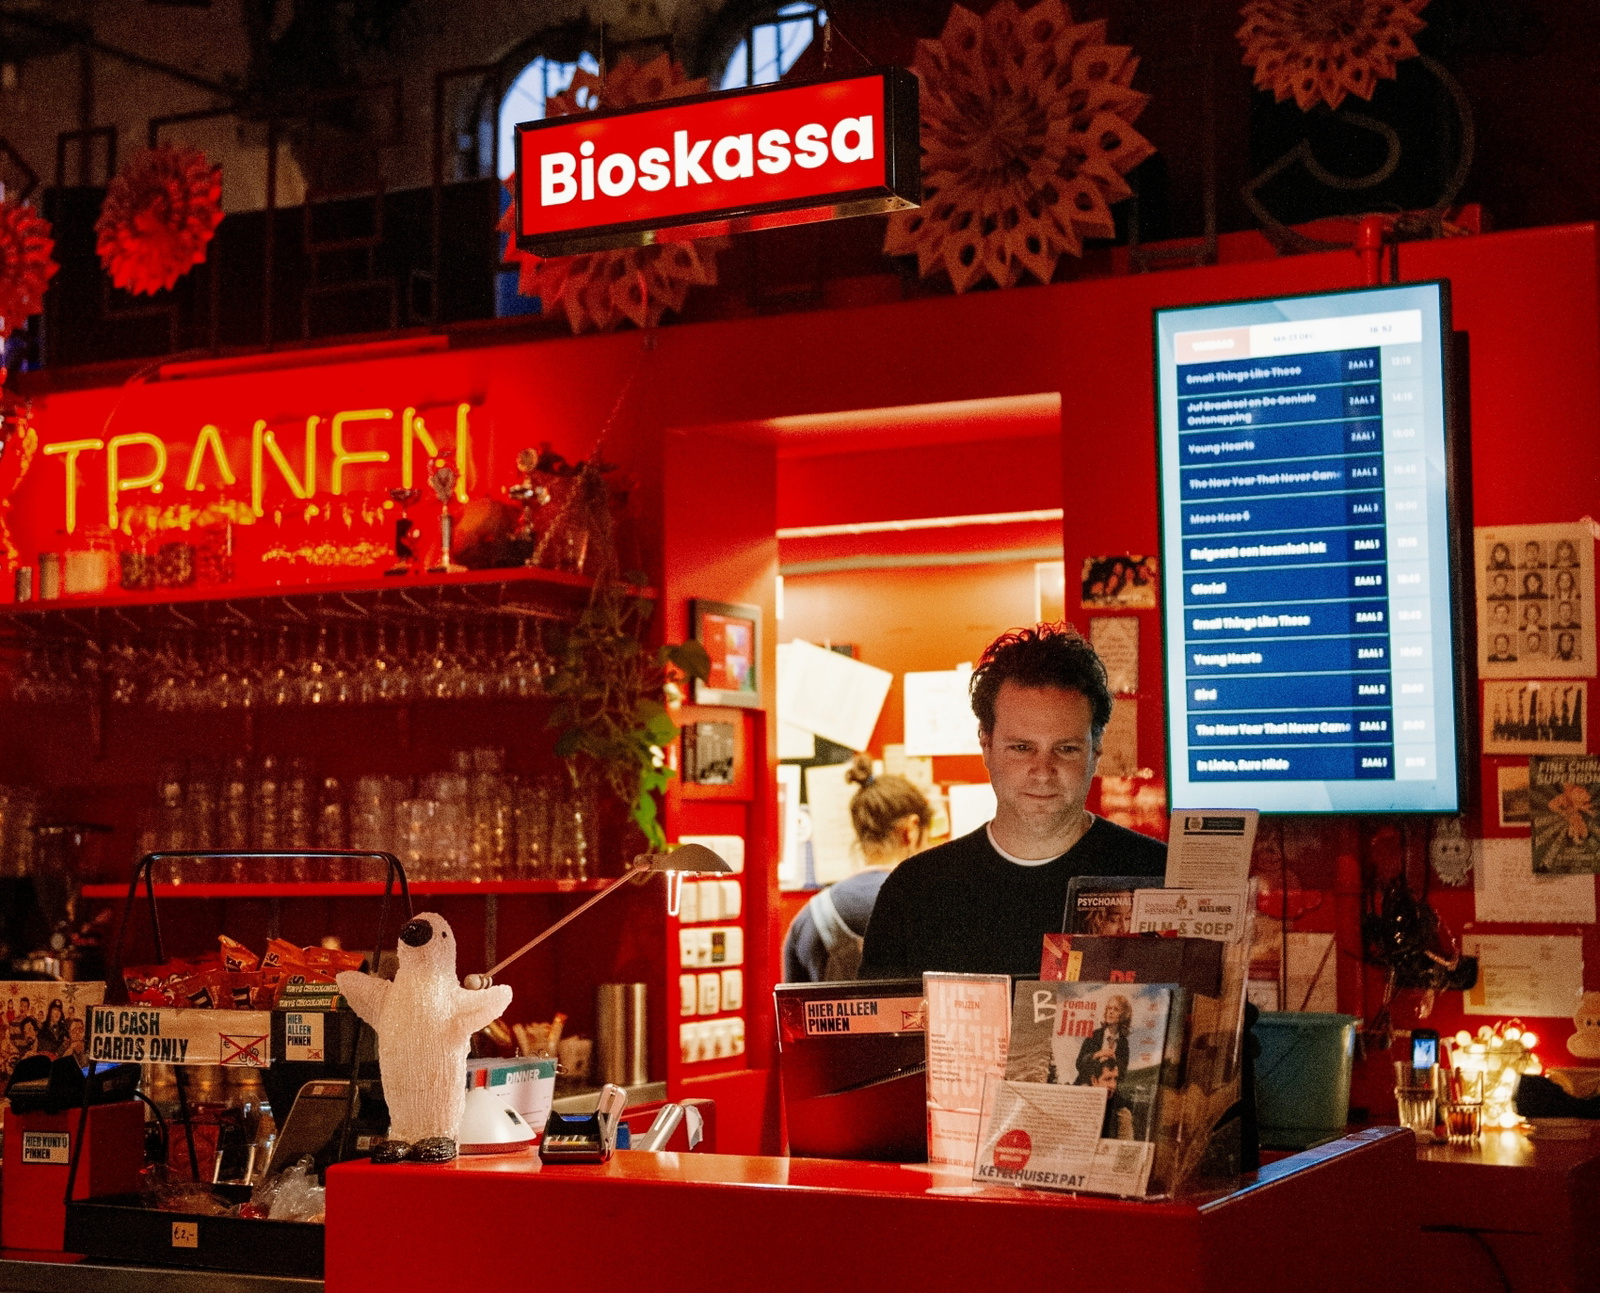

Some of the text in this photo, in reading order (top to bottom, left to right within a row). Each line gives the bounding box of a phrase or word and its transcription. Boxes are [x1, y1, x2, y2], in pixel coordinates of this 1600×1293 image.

[539, 114, 875, 208] Bioskassa
[1348, 360, 1368, 371] ZAAL
[1186, 366, 1302, 384] Small Things Like These
[1350, 396, 1369, 406] ZAAL
[1351, 431, 1371, 442] ZAAL
[1188, 440, 1255, 455] Young Hearts
[1352, 467, 1372, 478] ZAAL
[1189, 478, 1208, 489] The
[1208, 477, 1231, 489] New
[1231, 475, 1256, 487] Year
[1256, 473, 1280, 485] That
[1280, 472, 1312, 484] Never
[1353, 504, 1372, 514] ZAAL
[1354, 539, 1375, 550] ZAAL
[1354, 575, 1376, 586] ZAAL
[1356, 612, 1376, 622] ZAAL
[1192, 615, 1310, 631] Small Things Like These
[1358, 648, 1378, 658] ZAAL
[1193, 652, 1262, 667] Young Hearts
[1358, 684, 1379, 695] ZAAL
[1196, 723, 1215, 736] The
[1216, 723, 1238, 736] New
[1239, 723, 1264, 735] Year
[1264, 722, 1288, 735] That
[1288, 722, 1319, 734] Never
[1360, 721, 1380, 731] ZAAL
[1362, 757, 1382, 768] ZAAL
[1178, 922, 1188, 935] &
[1193, 922, 1234, 936] SOEP
[807, 1001, 878, 1018] HIER ALLEEN
[1063, 1000, 1097, 1011] roman
[94, 1010, 160, 1036] NO CASH
[287, 1014, 303, 1025] HIER
[808, 1017, 850, 1032] PINNEN
[1057, 1009, 1095, 1037] Jim
[287, 1025, 311, 1035] ALLEEN
[287, 1036, 311, 1047] PINNEN
[92, 1036, 189, 1063] CARDS ONLY
[505, 1068, 540, 1085] DINNER
[25, 1135, 68, 1148] HIER KUNT U
[25, 1147, 50, 1159] PINNEN
